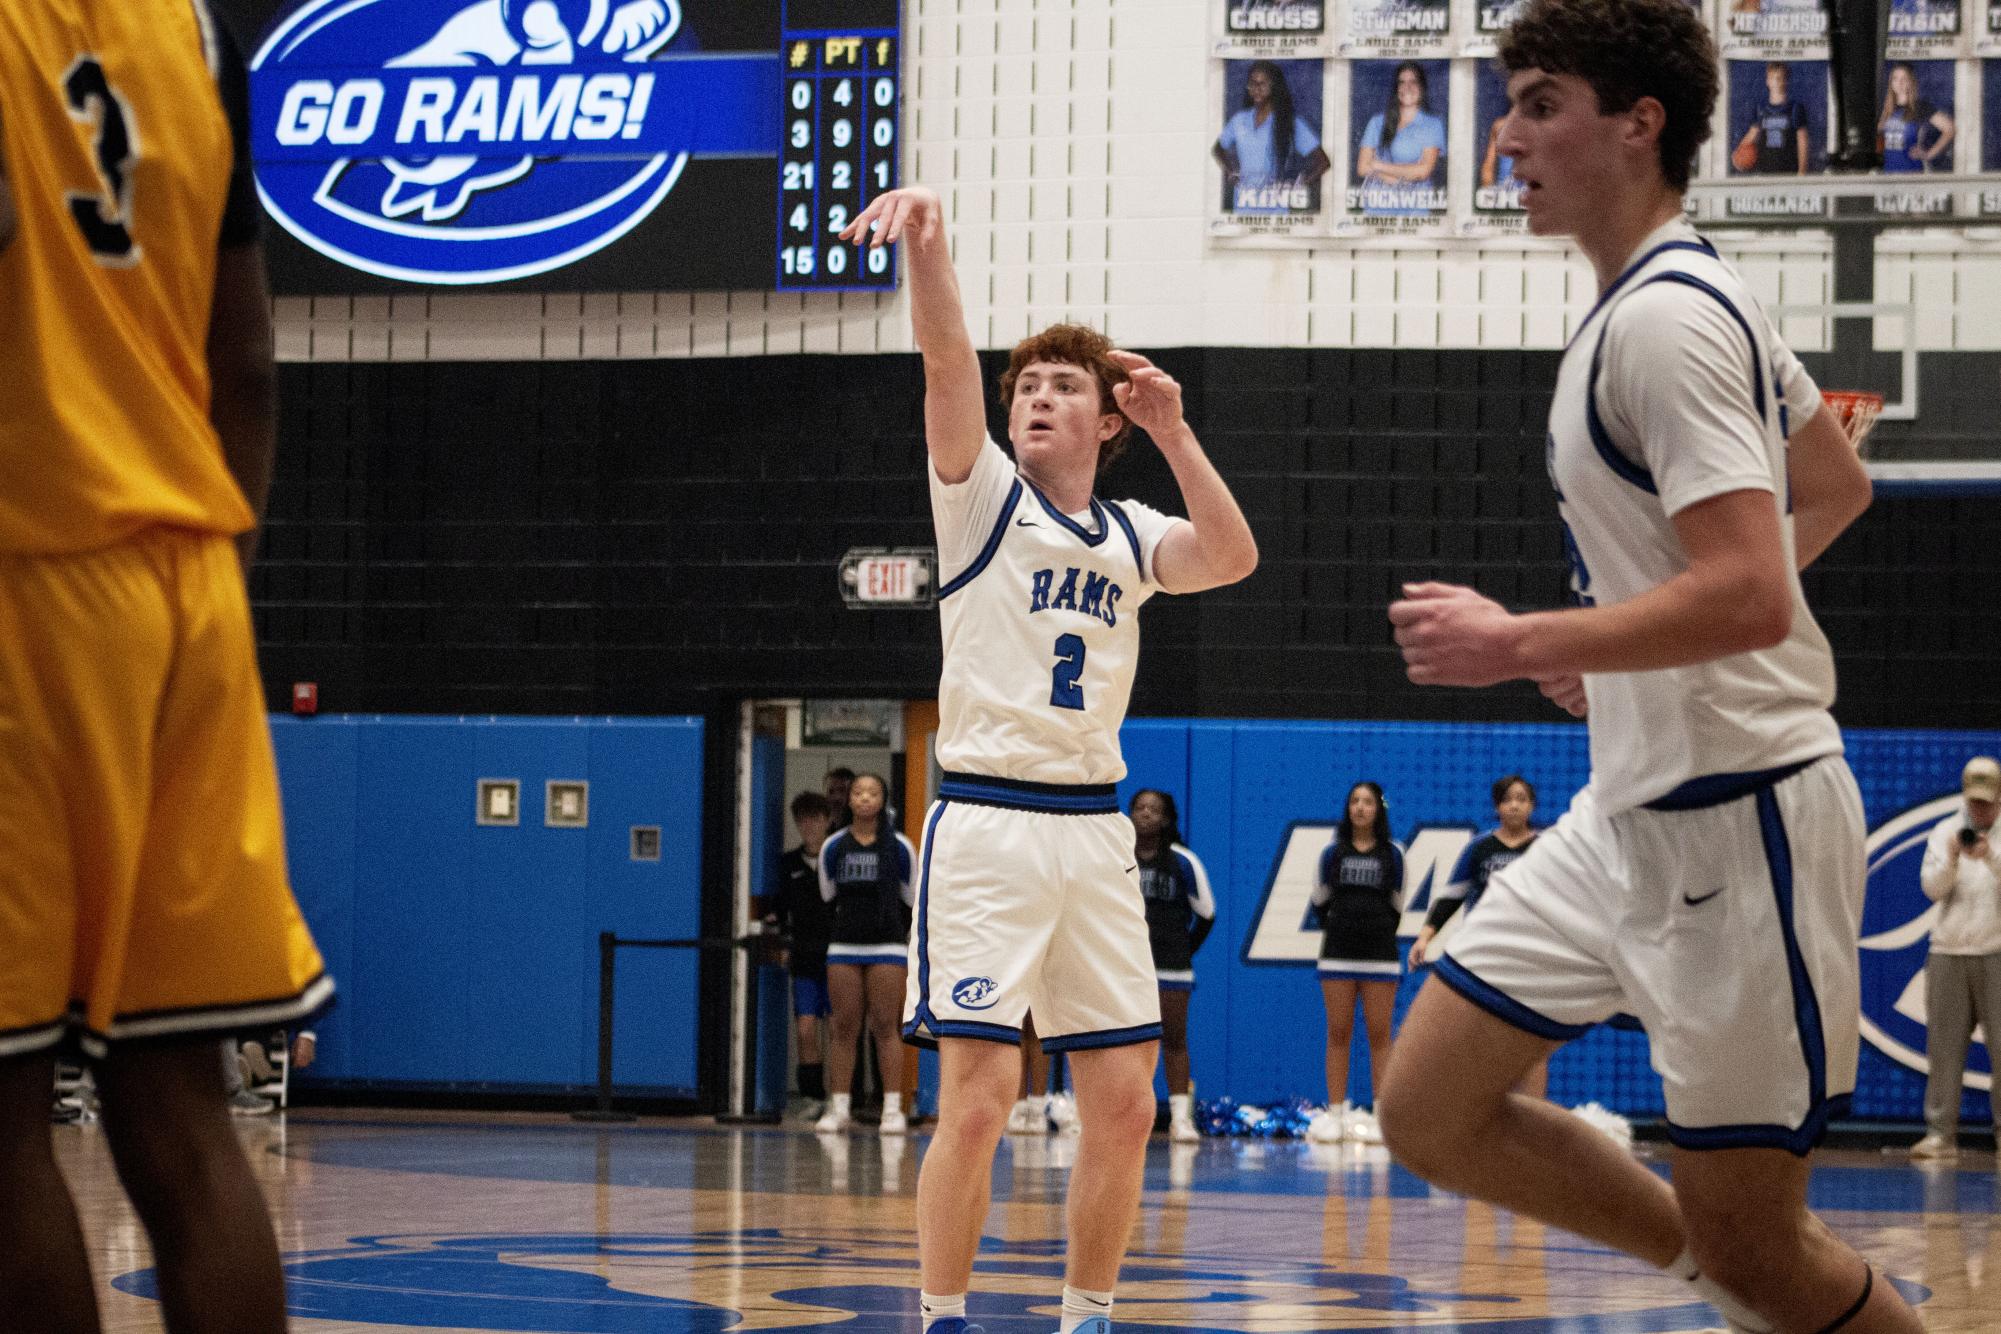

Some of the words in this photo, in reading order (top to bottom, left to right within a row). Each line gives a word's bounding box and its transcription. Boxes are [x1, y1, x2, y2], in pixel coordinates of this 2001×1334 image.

[1230, 9, 1320, 29] CROSS
[790, 41, 809, 67] #
[825, 37, 863, 65] PT
[876, 38, 890, 66] f
[275, 78, 385, 146] GO
[395, 71, 656, 144] RAMS!
[792, 81, 810, 110] 0
[833, 78, 852, 107] 4
[874, 78, 894, 107] 0
[791, 119, 810, 148] 3
[832, 119, 852, 147] 9
[874, 118, 893, 147] 0
[783, 161, 814, 190] 21
[832, 160, 851, 189] 2
[874, 160, 889, 188] 1
[1237, 187, 1309, 208] KING
[790, 203, 809, 231] 4
[828, 204, 848, 233] 2
[781, 246, 814, 274] 15
[827, 245, 847, 274] 0
[868, 246, 888, 274] 0
[868, 561, 906, 595] EXIT
[1029, 567, 1123, 628] RAMS
[1049, 632, 1086, 711] 2
